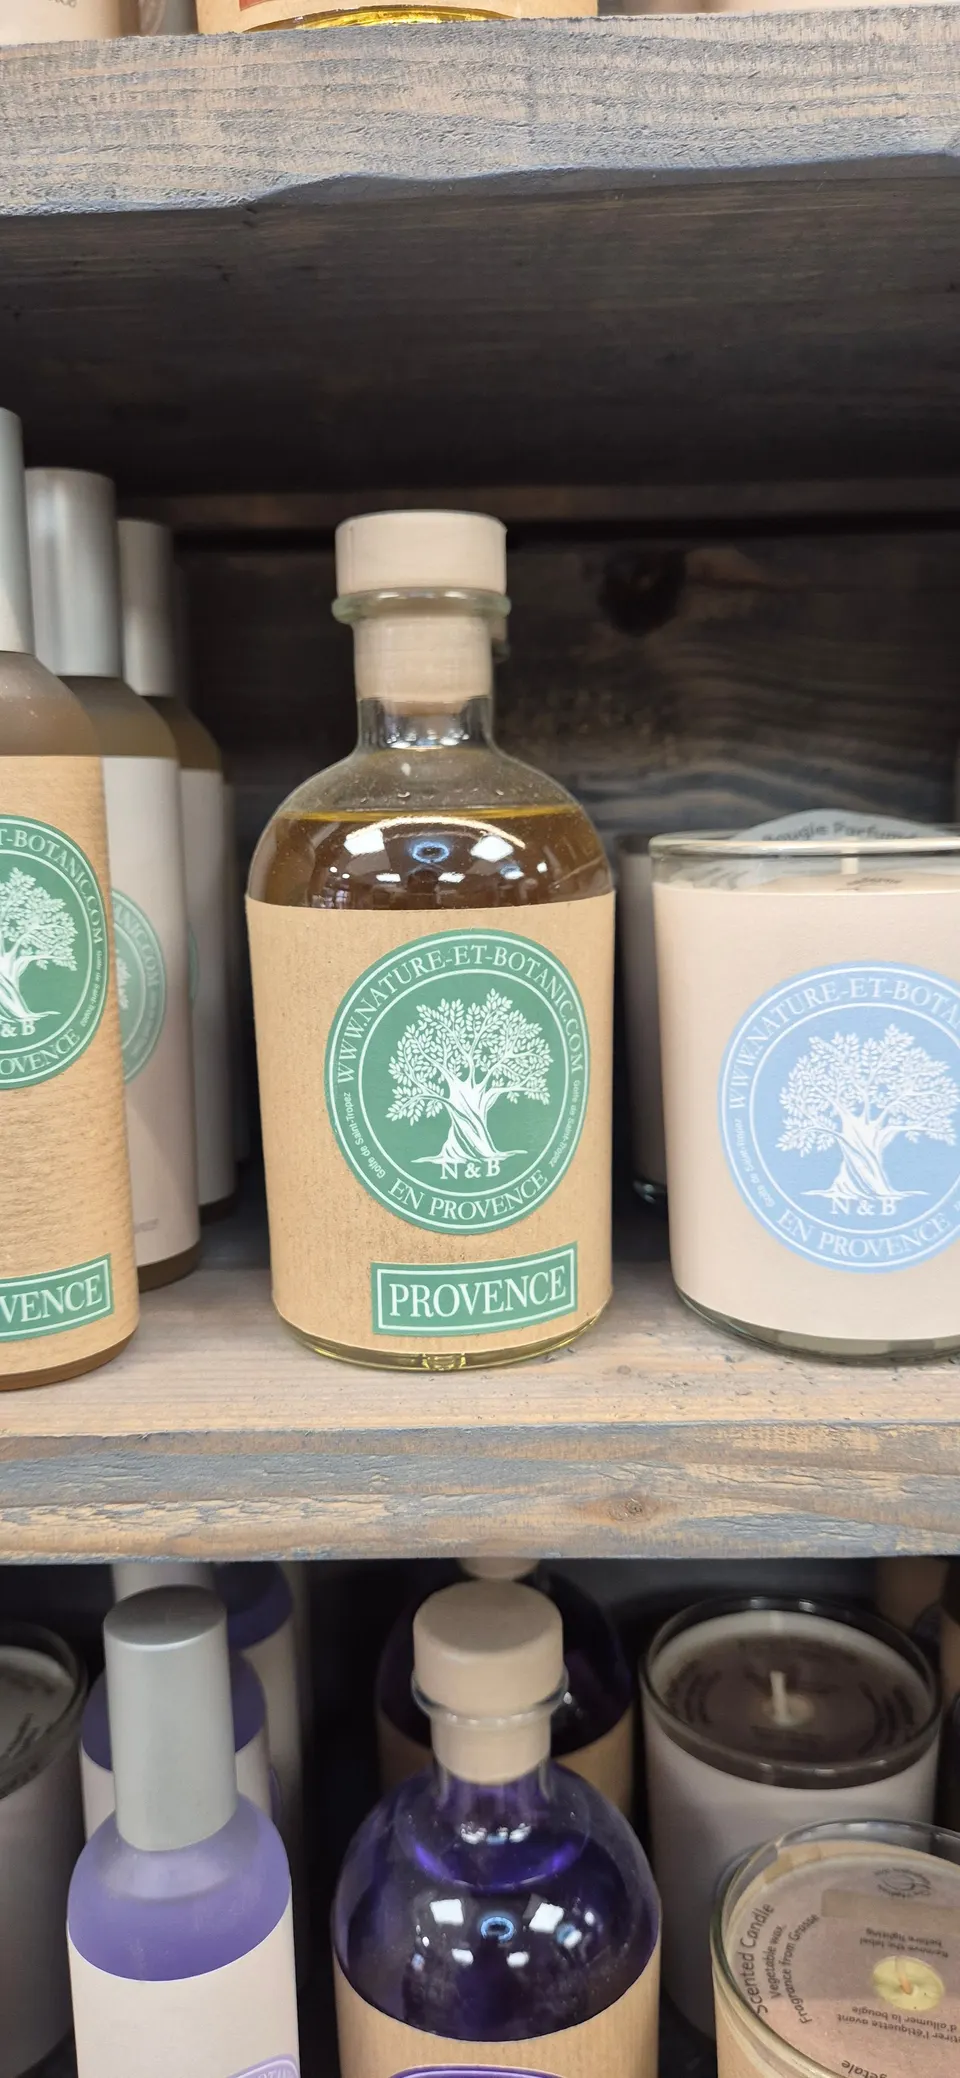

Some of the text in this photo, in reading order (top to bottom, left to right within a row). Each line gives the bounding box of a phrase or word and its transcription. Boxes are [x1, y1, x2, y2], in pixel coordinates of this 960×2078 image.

[21, 1020, 36, 1036] B
[337, 944, 583, 1084] WWW.NATURE-ET-BOTANIC.COM
[729, 977, 960, 1109] WWW.NATURE-ET-BOTA
[343, 1091, 386, 1179] Golfe de Saint-Tropez
[440, 1159, 501, 1179] N & B
[387, 1169, 549, 1220] EN PROVENCE
[831, 1198, 897, 1216] N & B
[777, 1209, 951, 1258] EN PROVENCE
[0, 1274, 103, 1323] VENCE
[389, 1264, 567, 1318] PROVENCE
[738, 1903, 774, 2015] Scented Candle
[778, 1942, 796, 1966] from
[782, 1967, 812, 2024] Fragrance
[837, 2013, 868, 2026] avant
[851, 2006, 889, 2021] bougie
[891, 2012, 902, 2024] la
